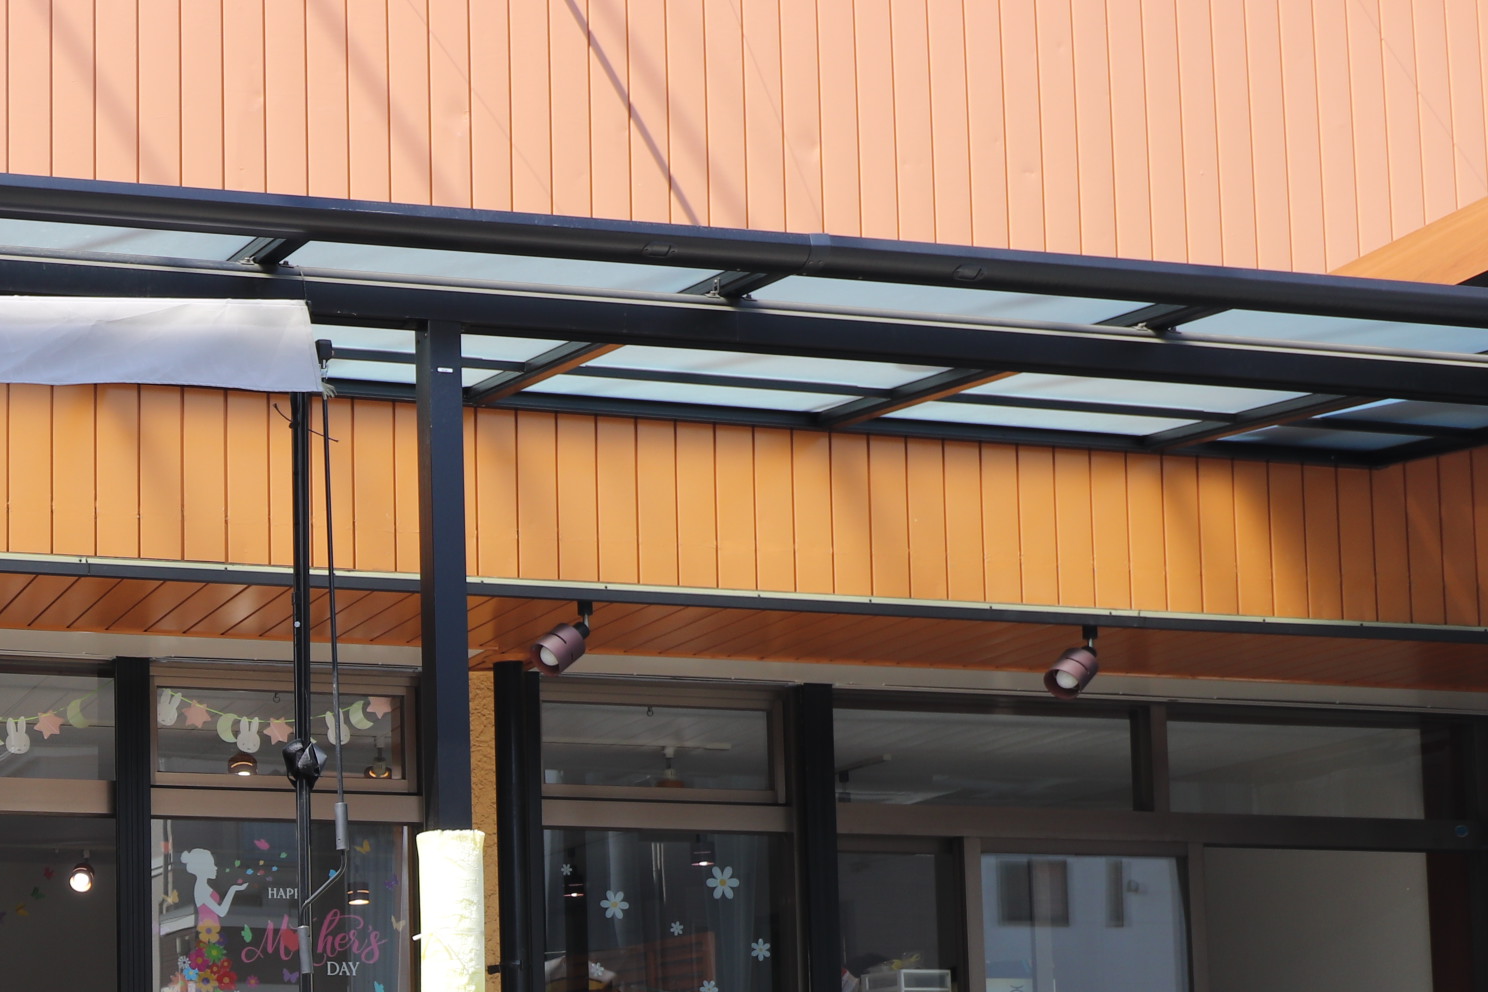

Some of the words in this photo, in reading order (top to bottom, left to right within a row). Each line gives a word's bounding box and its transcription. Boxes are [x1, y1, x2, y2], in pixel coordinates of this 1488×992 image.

[268, 887, 299, 899] HAP
[241, 908, 388, 966] Mher's
[327, 961, 360, 976] DAY
